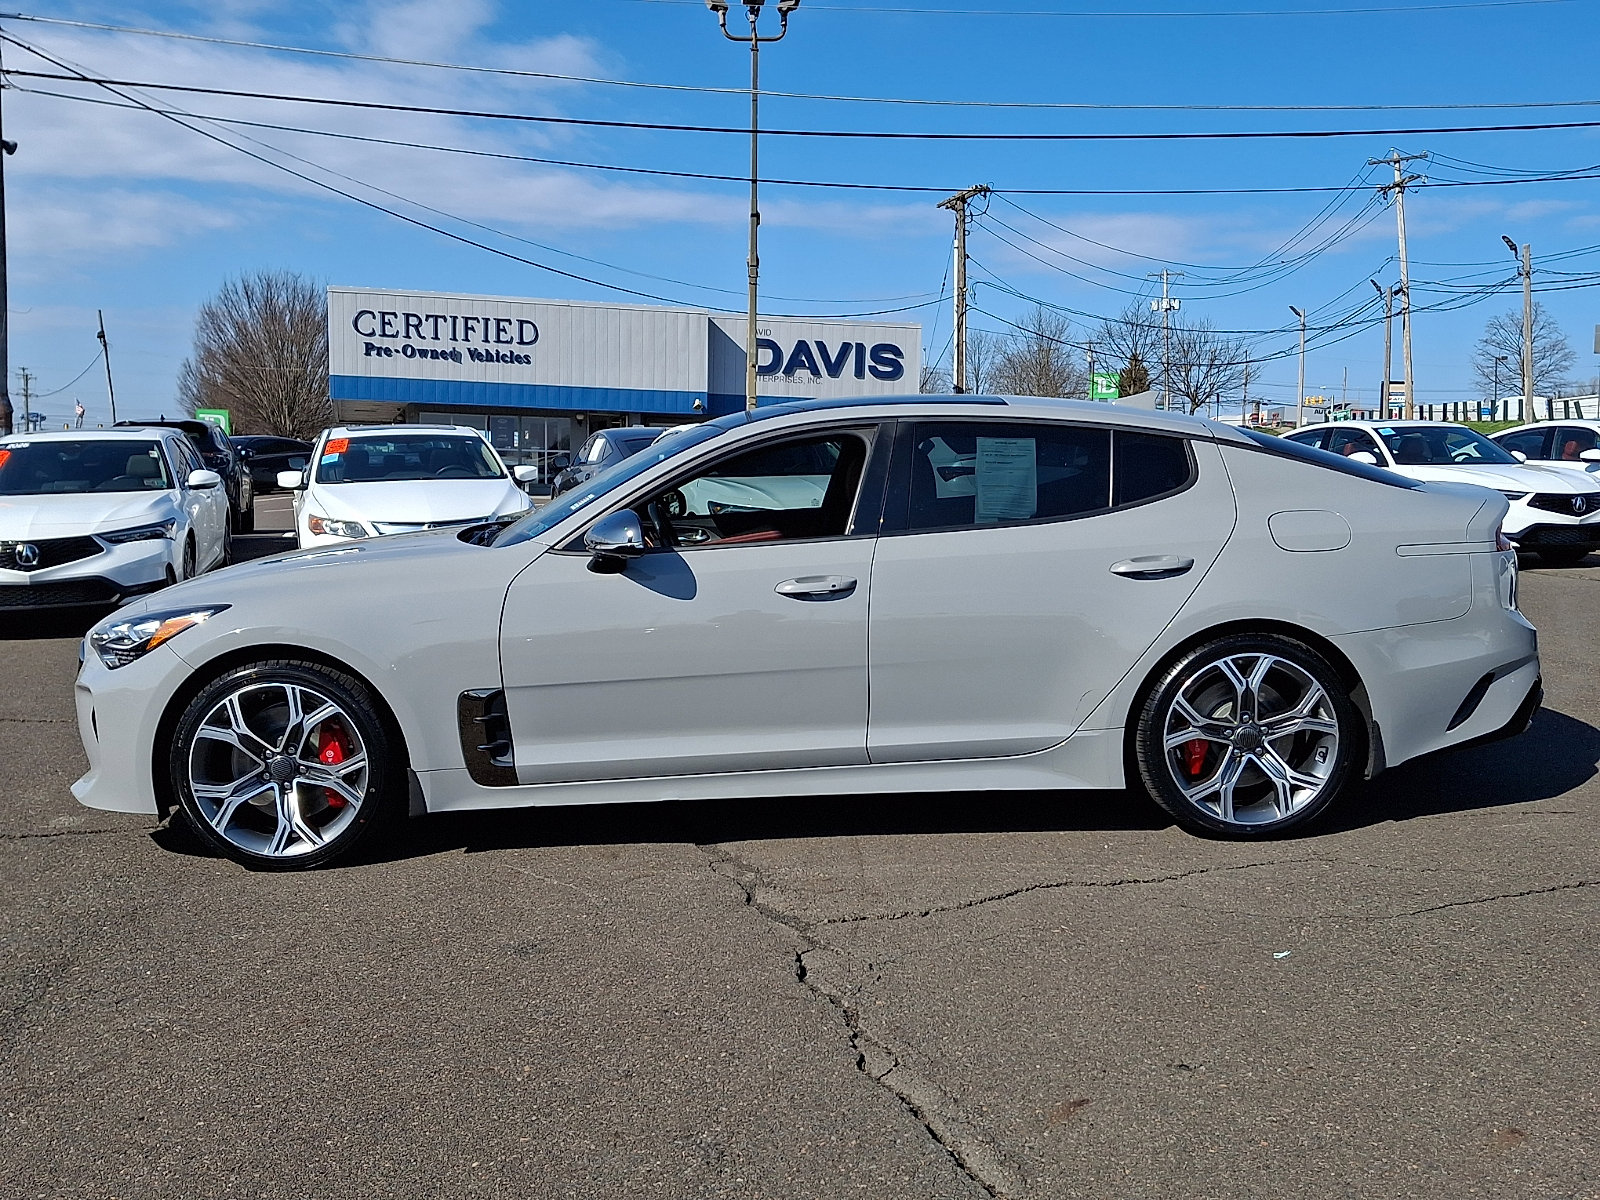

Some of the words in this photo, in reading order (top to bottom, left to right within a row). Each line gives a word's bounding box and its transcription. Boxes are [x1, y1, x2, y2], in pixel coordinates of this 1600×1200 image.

[352, 309, 540, 346] CERTIFIED
[363, 341, 463, 364] Pre-Owned
[466, 347, 532, 365] Vehicles
[756, 338, 905, 382] DAVIS
[756, 374, 806, 385] TERPRISES,
